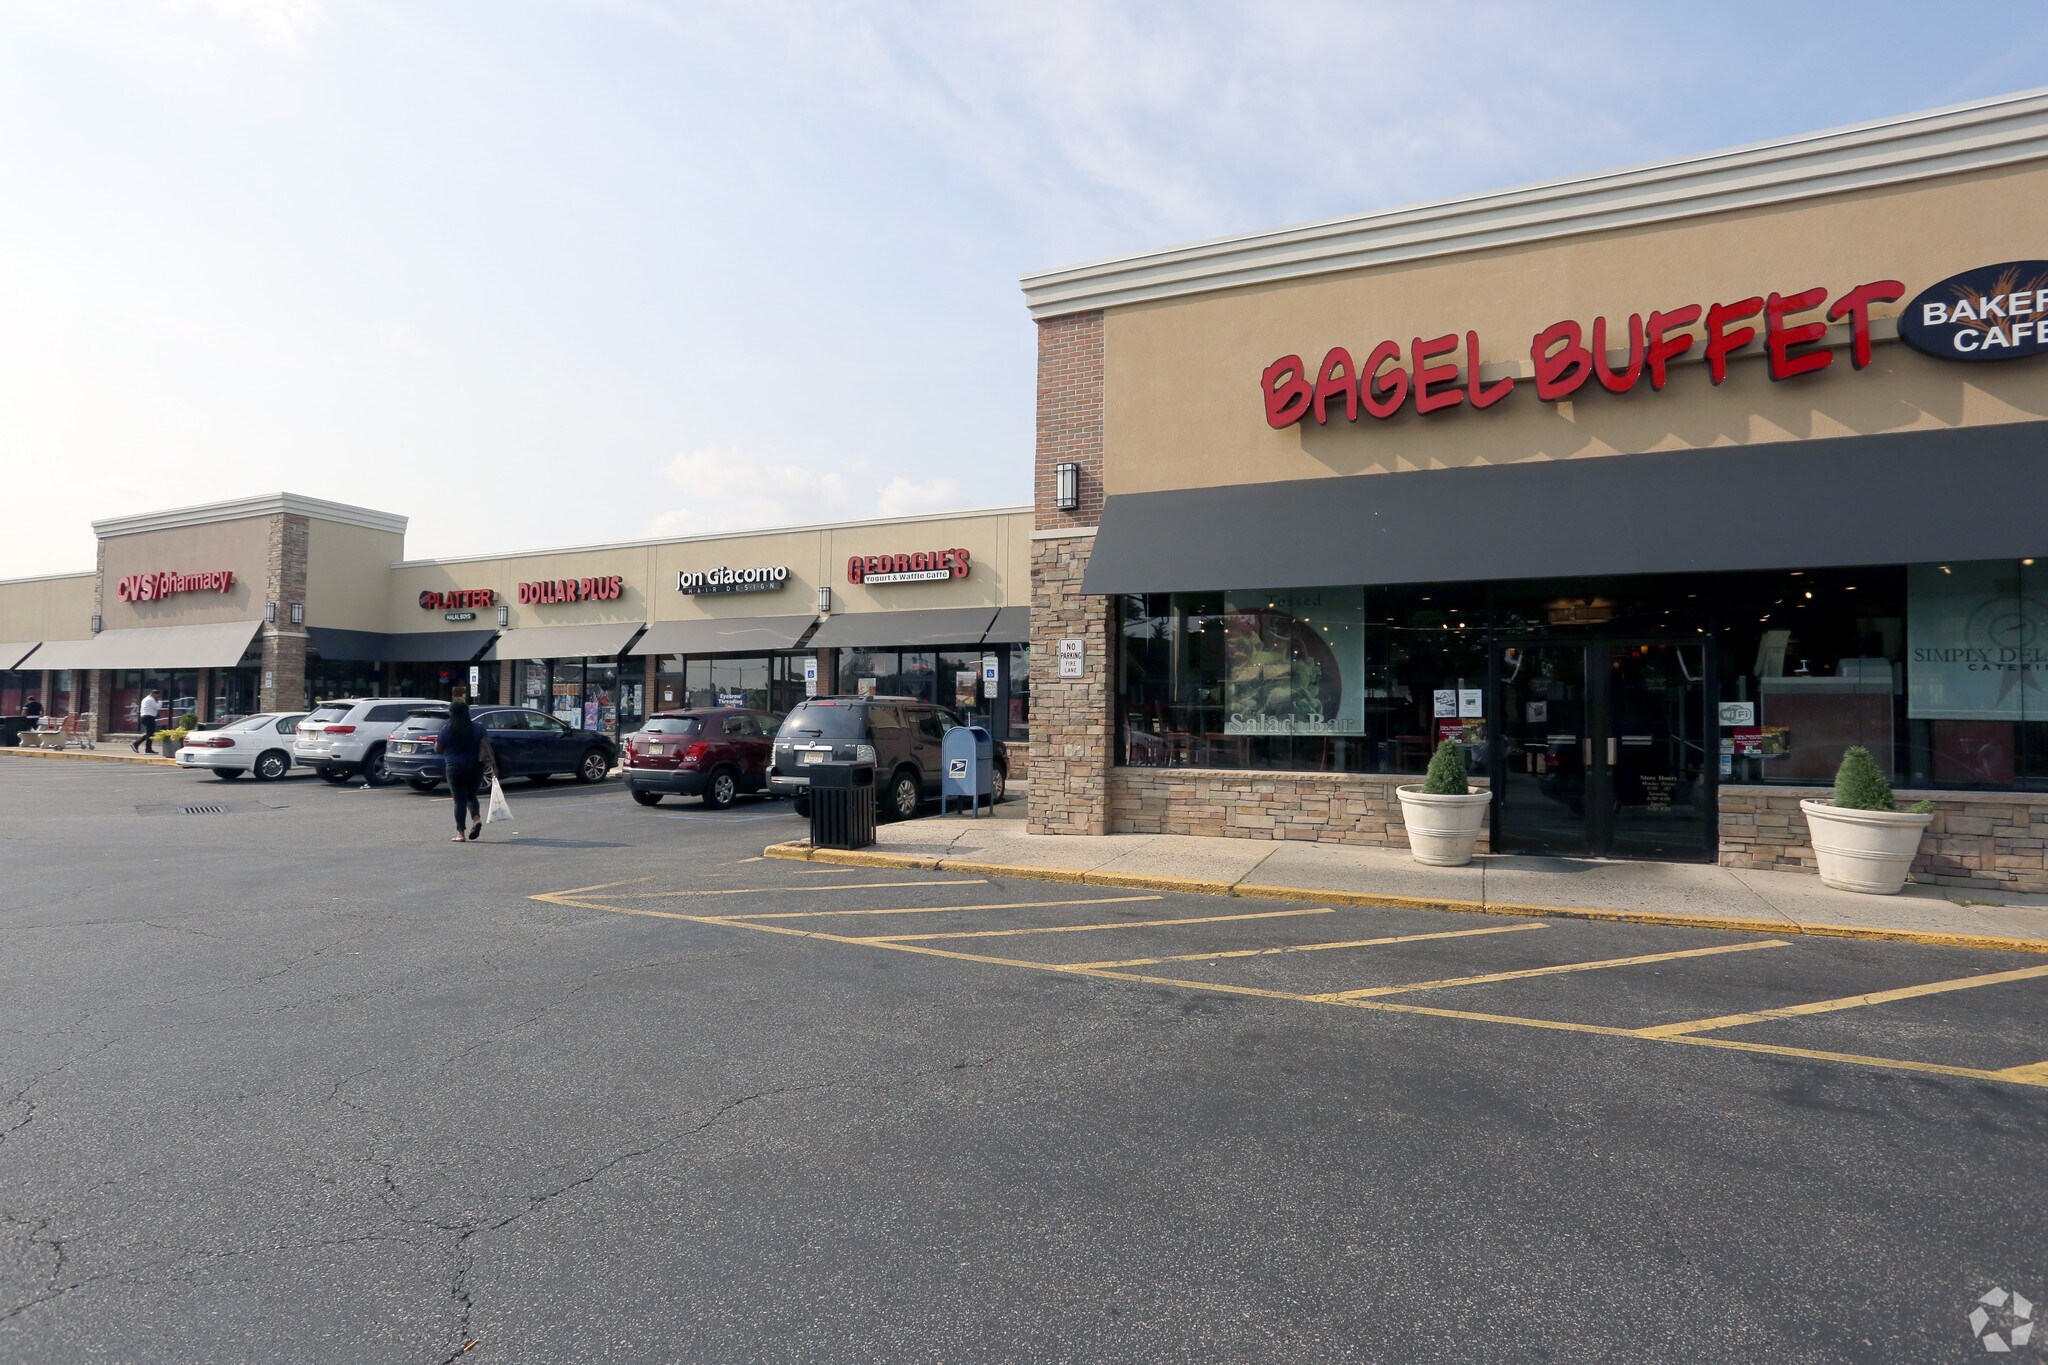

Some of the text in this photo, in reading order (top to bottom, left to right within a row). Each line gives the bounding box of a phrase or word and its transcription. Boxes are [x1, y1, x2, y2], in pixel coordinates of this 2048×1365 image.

[1260, 280, 1905, 430] BAGEL BUFFET
[847, 548, 970, 584] GEORGIE'S
[116, 571, 233, 602] CVS/pharmacy
[676, 566, 788, 591] Jon Giacomo
[865, 575, 891, 583] Yogurt
[427, 589, 493, 609] PLATTER
[518, 575, 623, 604] DOLLAR PLUS
[1061, 652, 1081, 660] PARKING
[1913, 648, 1990, 662] SIMPLY
[1968, 663, 2048, 671] CATERI
[1230, 713, 1354, 733] Salad Bar
